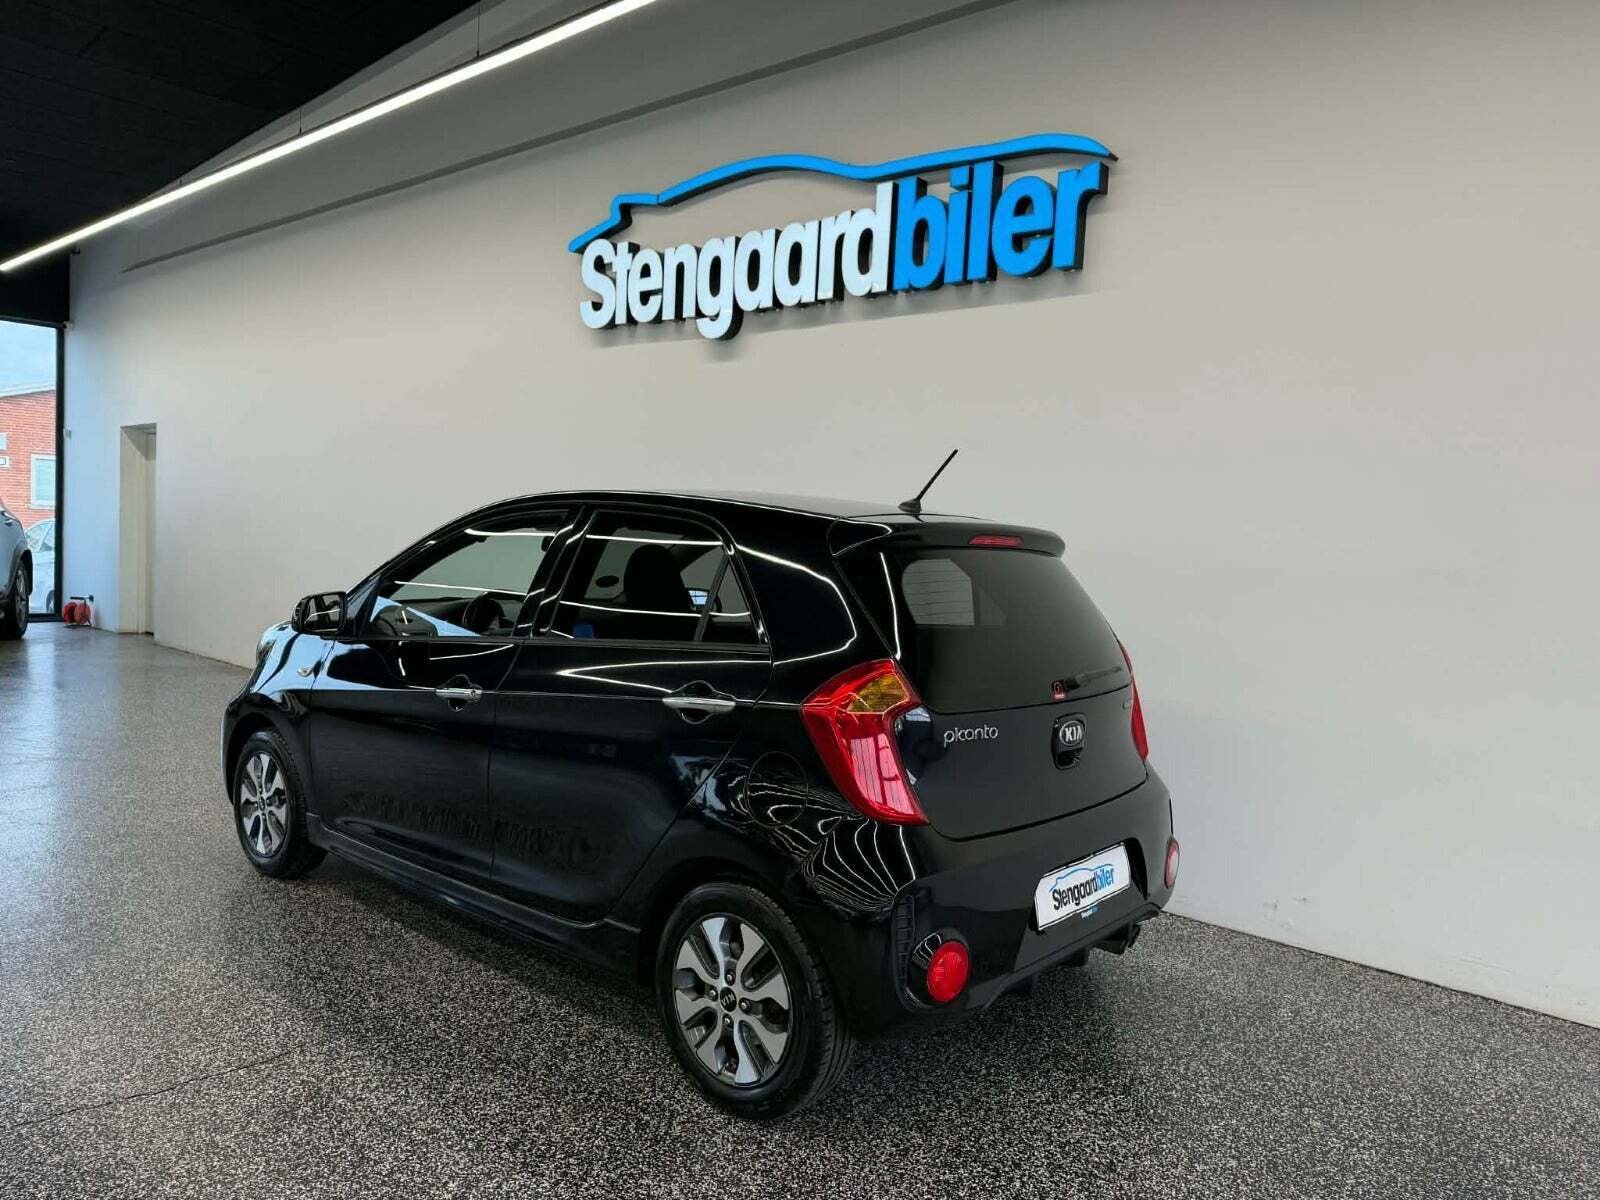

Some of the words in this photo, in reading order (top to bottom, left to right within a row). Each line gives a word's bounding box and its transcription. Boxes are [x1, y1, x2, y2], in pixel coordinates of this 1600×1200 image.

[579, 160, 1109, 340] Stengaardbiler
[1064, 725, 1083, 742] KIA
[1051, 868, 1114, 911] Stengaardbiler
